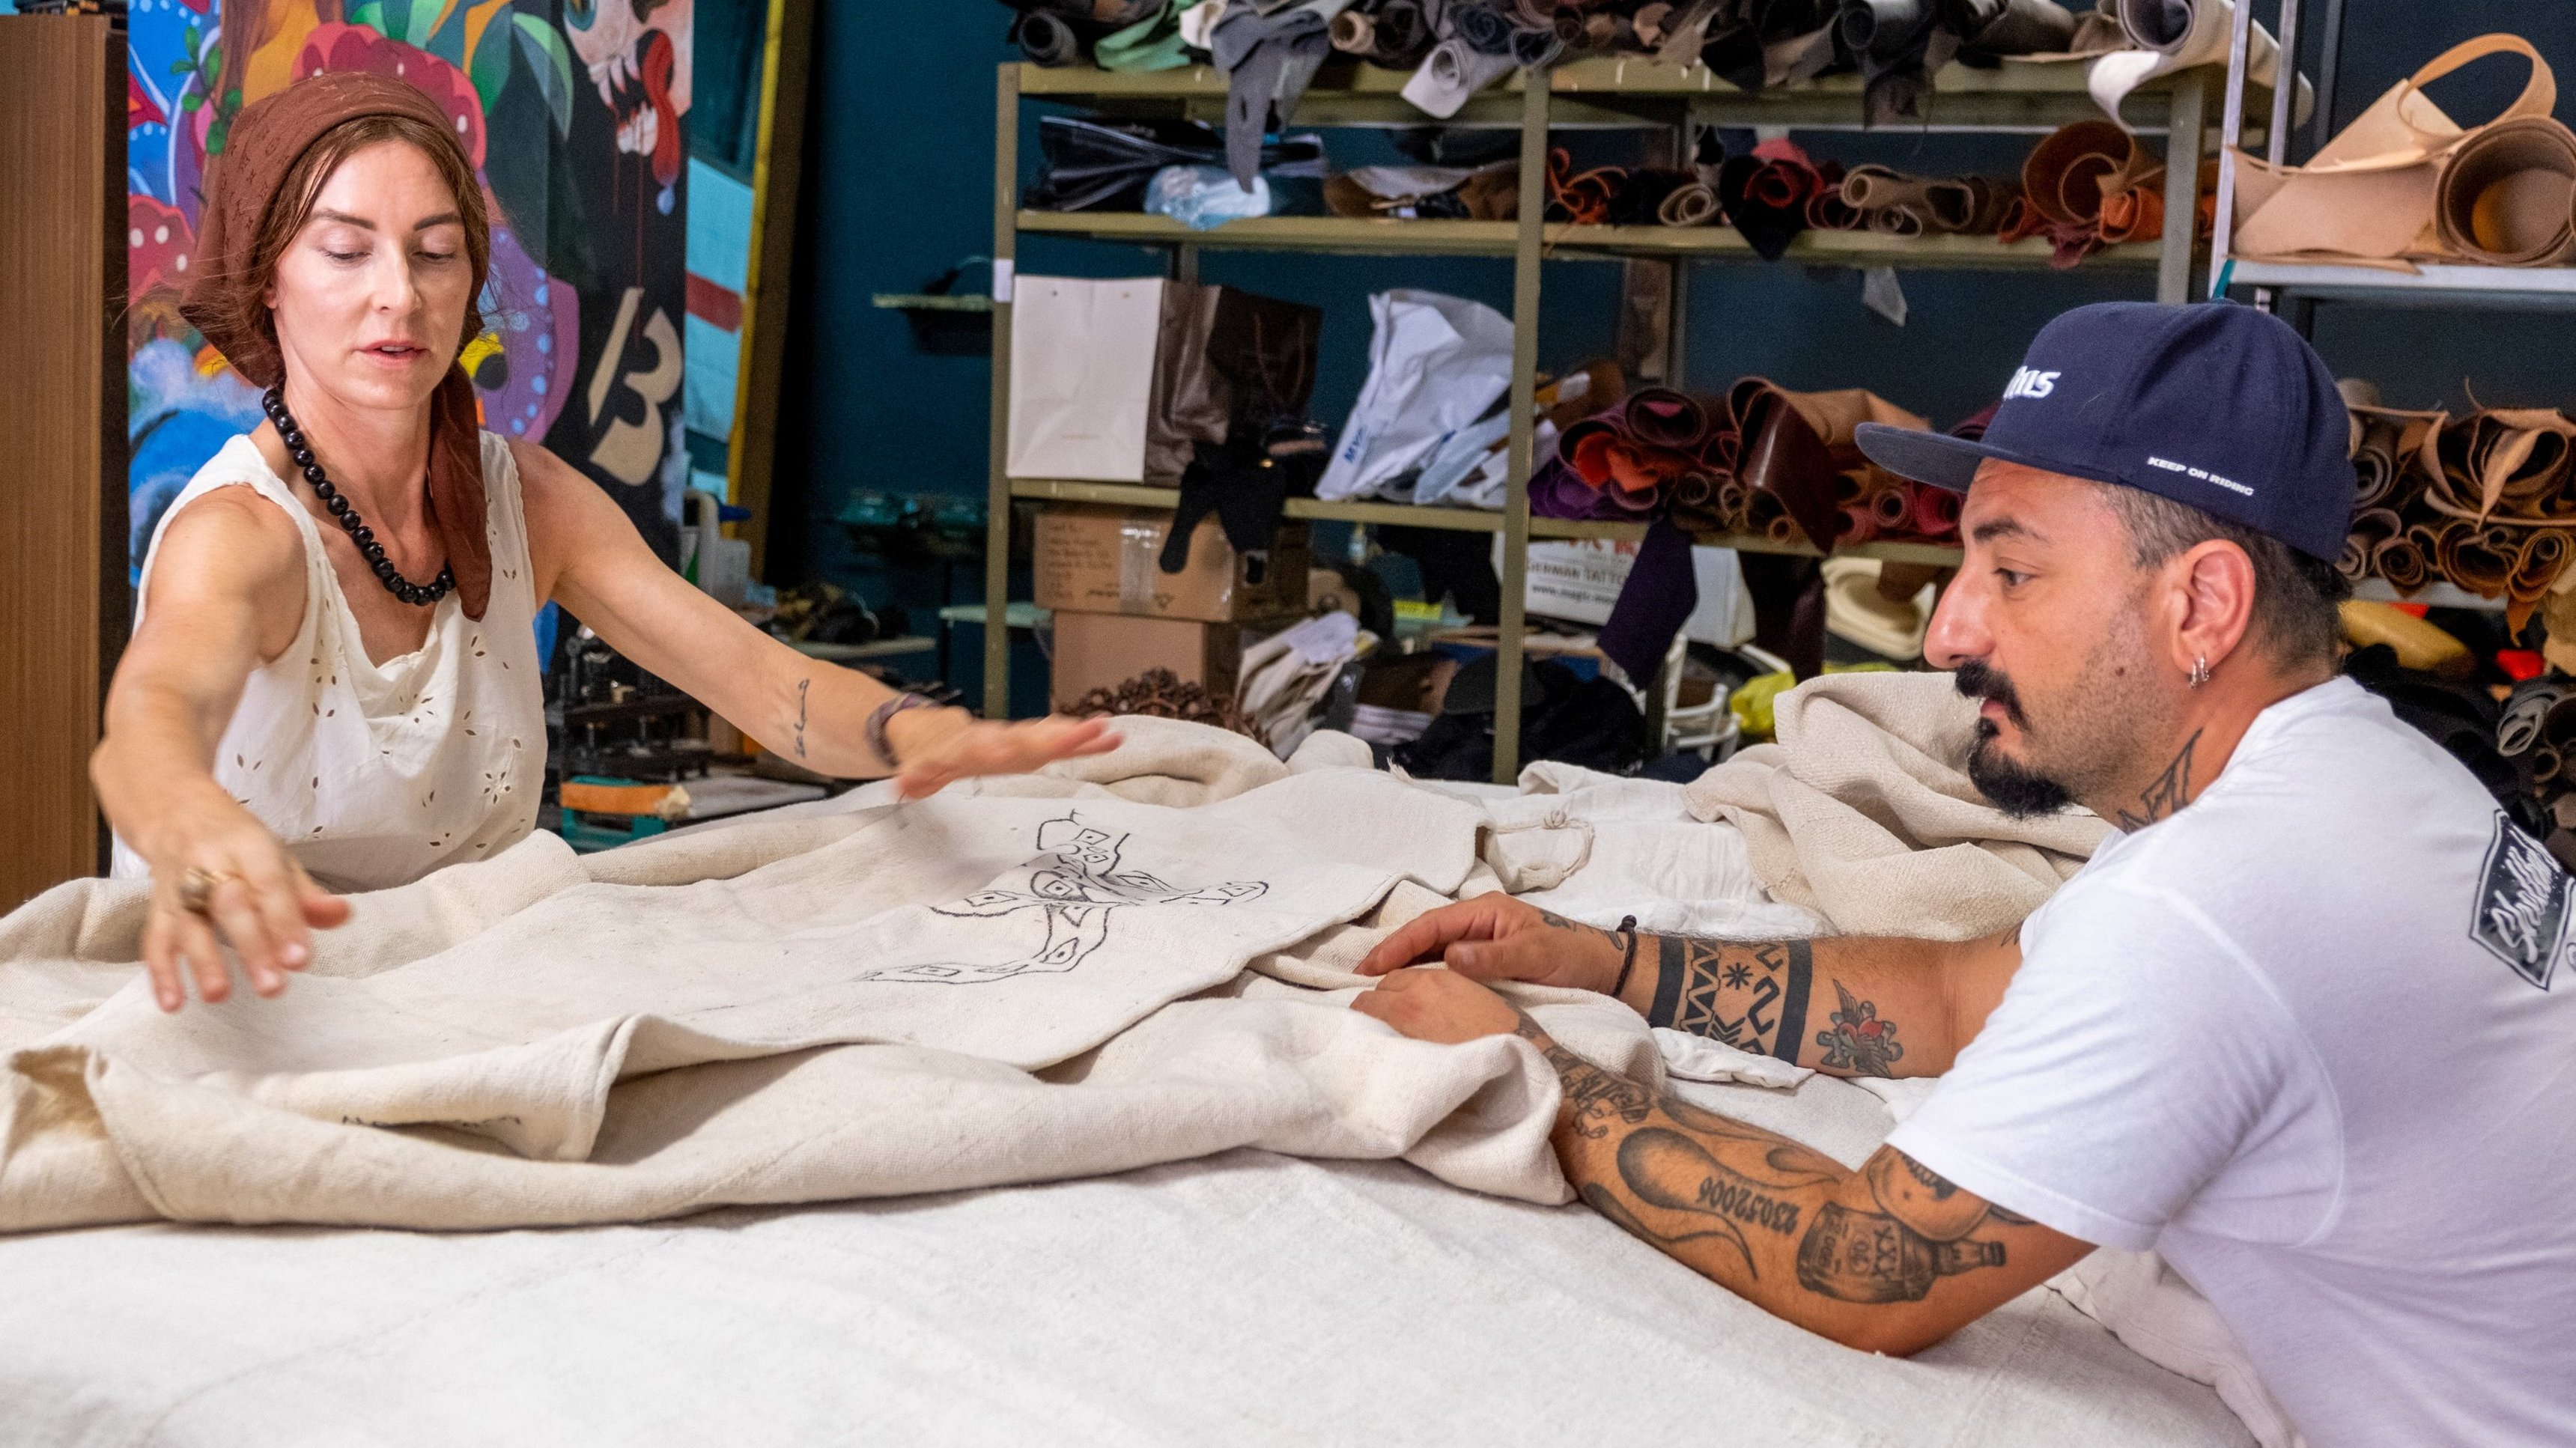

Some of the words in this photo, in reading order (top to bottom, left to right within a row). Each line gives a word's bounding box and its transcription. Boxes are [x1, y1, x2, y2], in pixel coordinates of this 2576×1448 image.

[2147, 457, 2187, 472] KEEP
[2187, 467, 2209, 480] ON
[2209, 474, 2255, 496] RIDING
